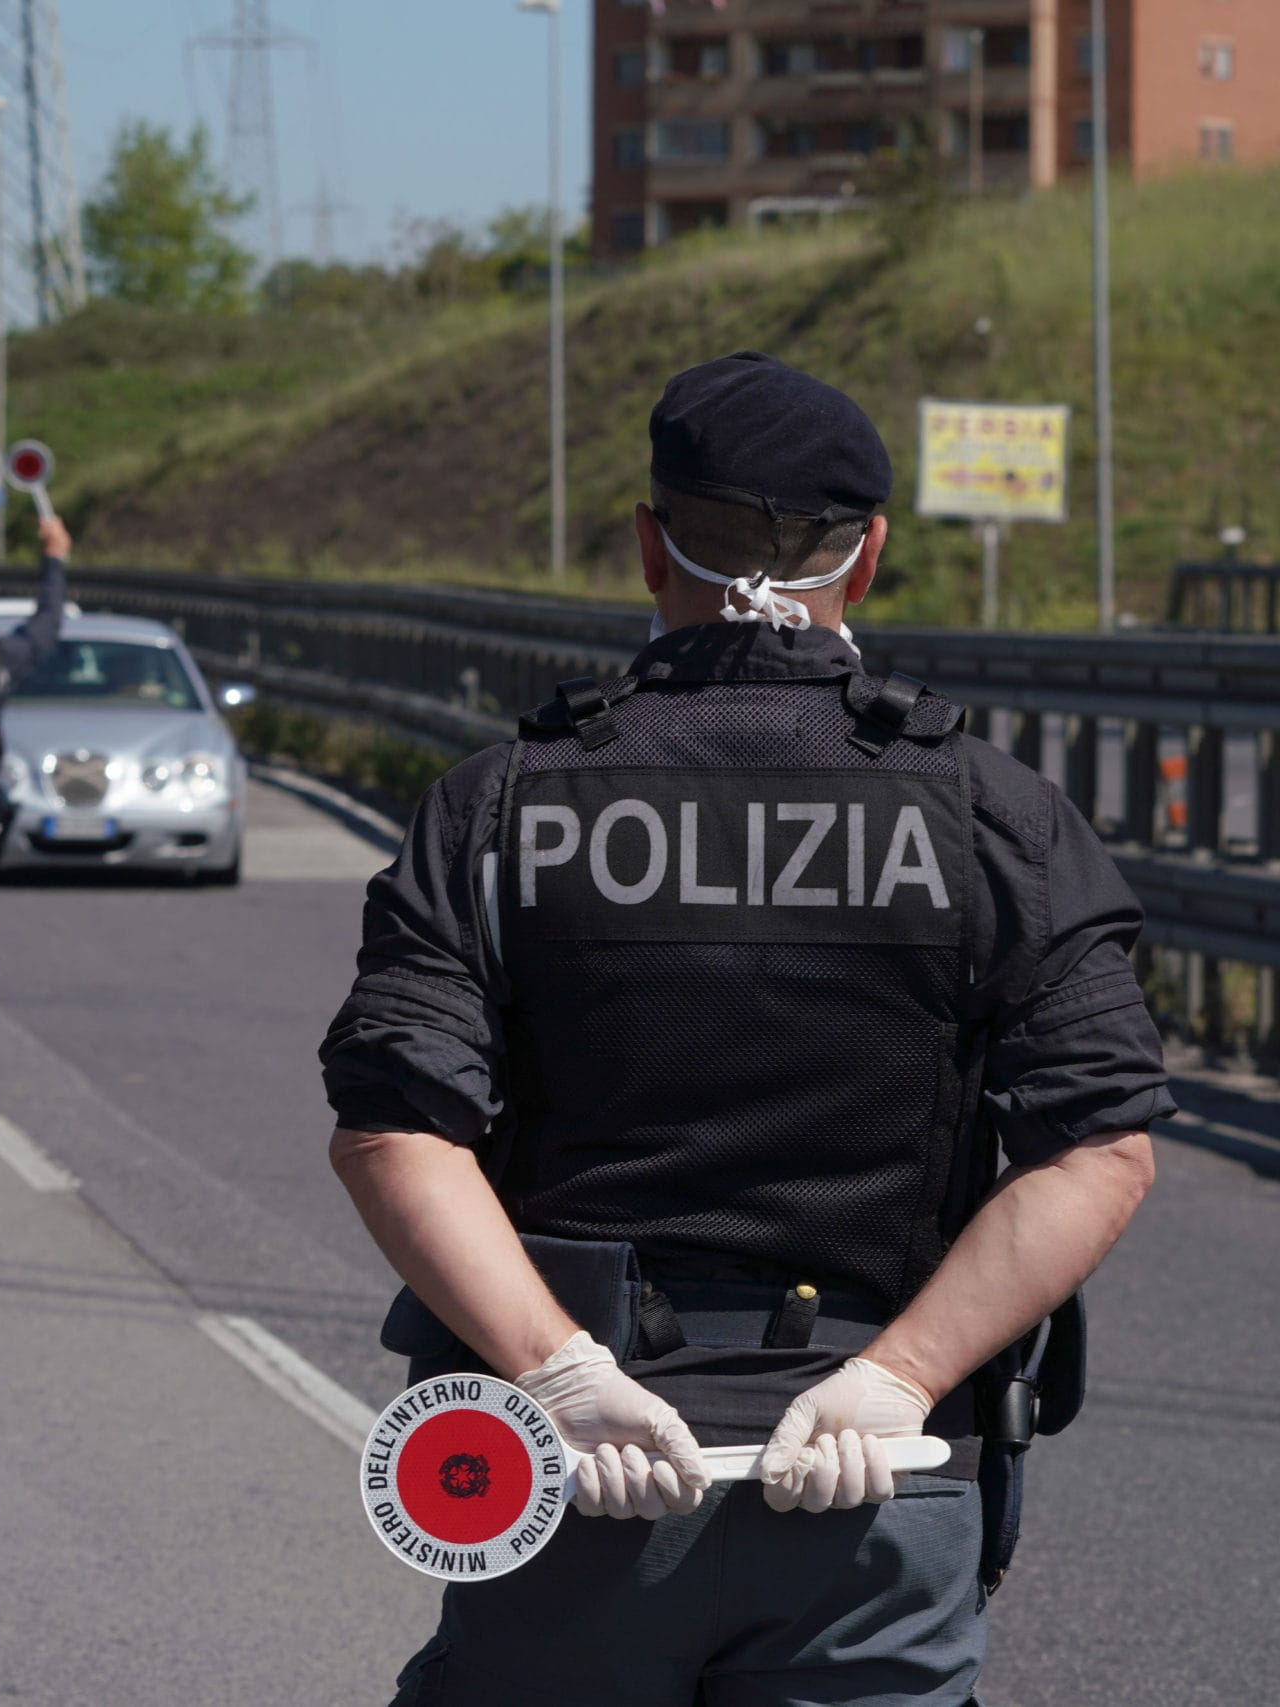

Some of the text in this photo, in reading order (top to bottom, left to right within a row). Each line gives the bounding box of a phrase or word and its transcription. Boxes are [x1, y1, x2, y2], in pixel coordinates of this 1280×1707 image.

[520, 798, 951, 909] POLIZIA
[368, 1380, 487, 1573] MINISTERO DELL'INTERNO
[504, 1394, 561, 1556] POLIZIA DI STATO
